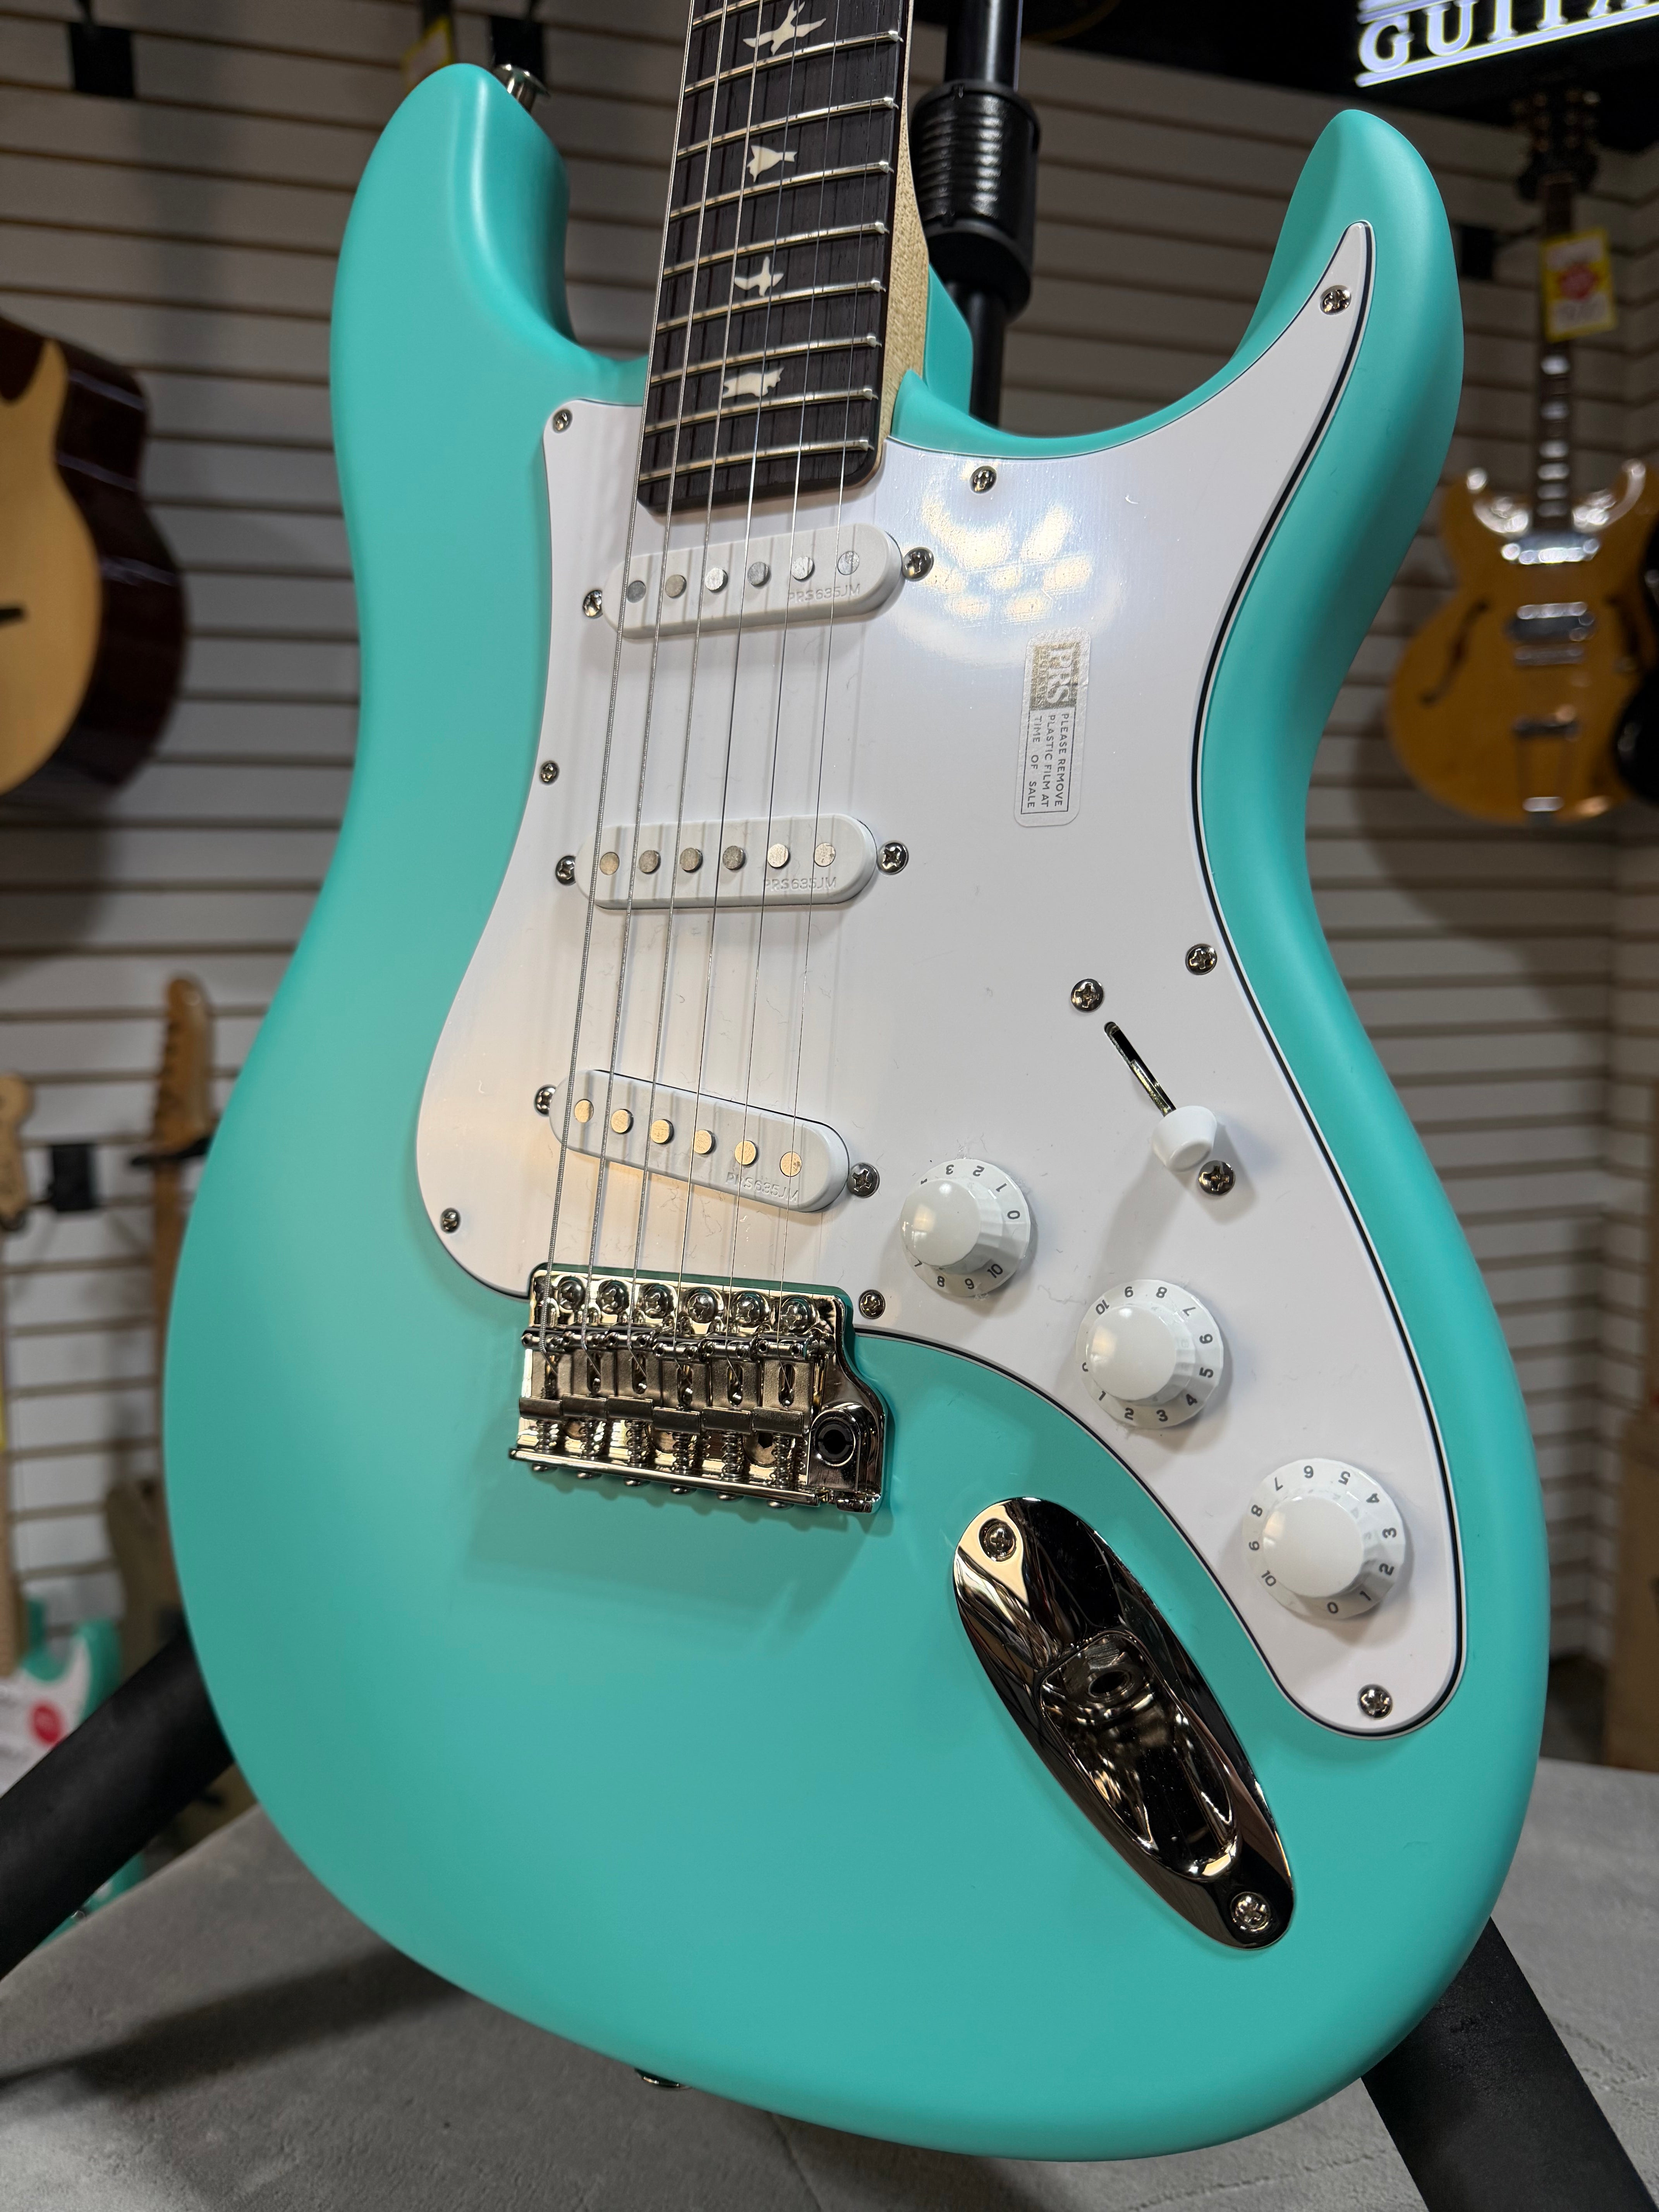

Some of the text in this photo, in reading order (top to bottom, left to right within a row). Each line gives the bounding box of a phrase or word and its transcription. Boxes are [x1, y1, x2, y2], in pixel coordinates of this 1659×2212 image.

[1358, 0, 1647, 73] GUI
[788, 583, 860, 602] PRS635JM
[1046, 648, 1073, 703] PRS
[1033, 716, 1042, 742] TIME
[1031, 755, 1039, 769] OF
[1041, 715, 1056, 807] PLASTIC FILM AT
[1054, 713, 1069, 806] PLEASE REMOVE
[1027, 781, 1037, 808] SALE
[764, 876, 836, 891] PRS635JM
[946, 1164, 954, 1175] 3
[972, 1165, 985, 1176] 2
[725, 1172, 799, 1203] PRS635JM
[996, 1183, 1007, 1192] 1
[1007, 1210, 1020, 1219] 0
[987, 1264, 1003, 1278] 10
[937, 1276, 945, 1288] 8
[965, 1278, 974, 1289] 9
[1125, 1286, 1133, 1297] 9
[1156, 1287, 1167, 1298] 8
[1096, 1300, 1109, 1315] 10
[1183, 1307, 1196, 1316] 7
[1199, 1334, 1213, 1344] 6
[1199, 1367, 1213, 1378] 5
[1099, 1391, 1106, 1401] 1
[1186, 1394, 1197, 1406] 4
[1124, 1408, 1134, 1420] 2
[1156, 1410, 1168, 1422] 3
[1249, 1465, 1397, 1614] 0 1 2 3 4 5 6 7 8 9 10
